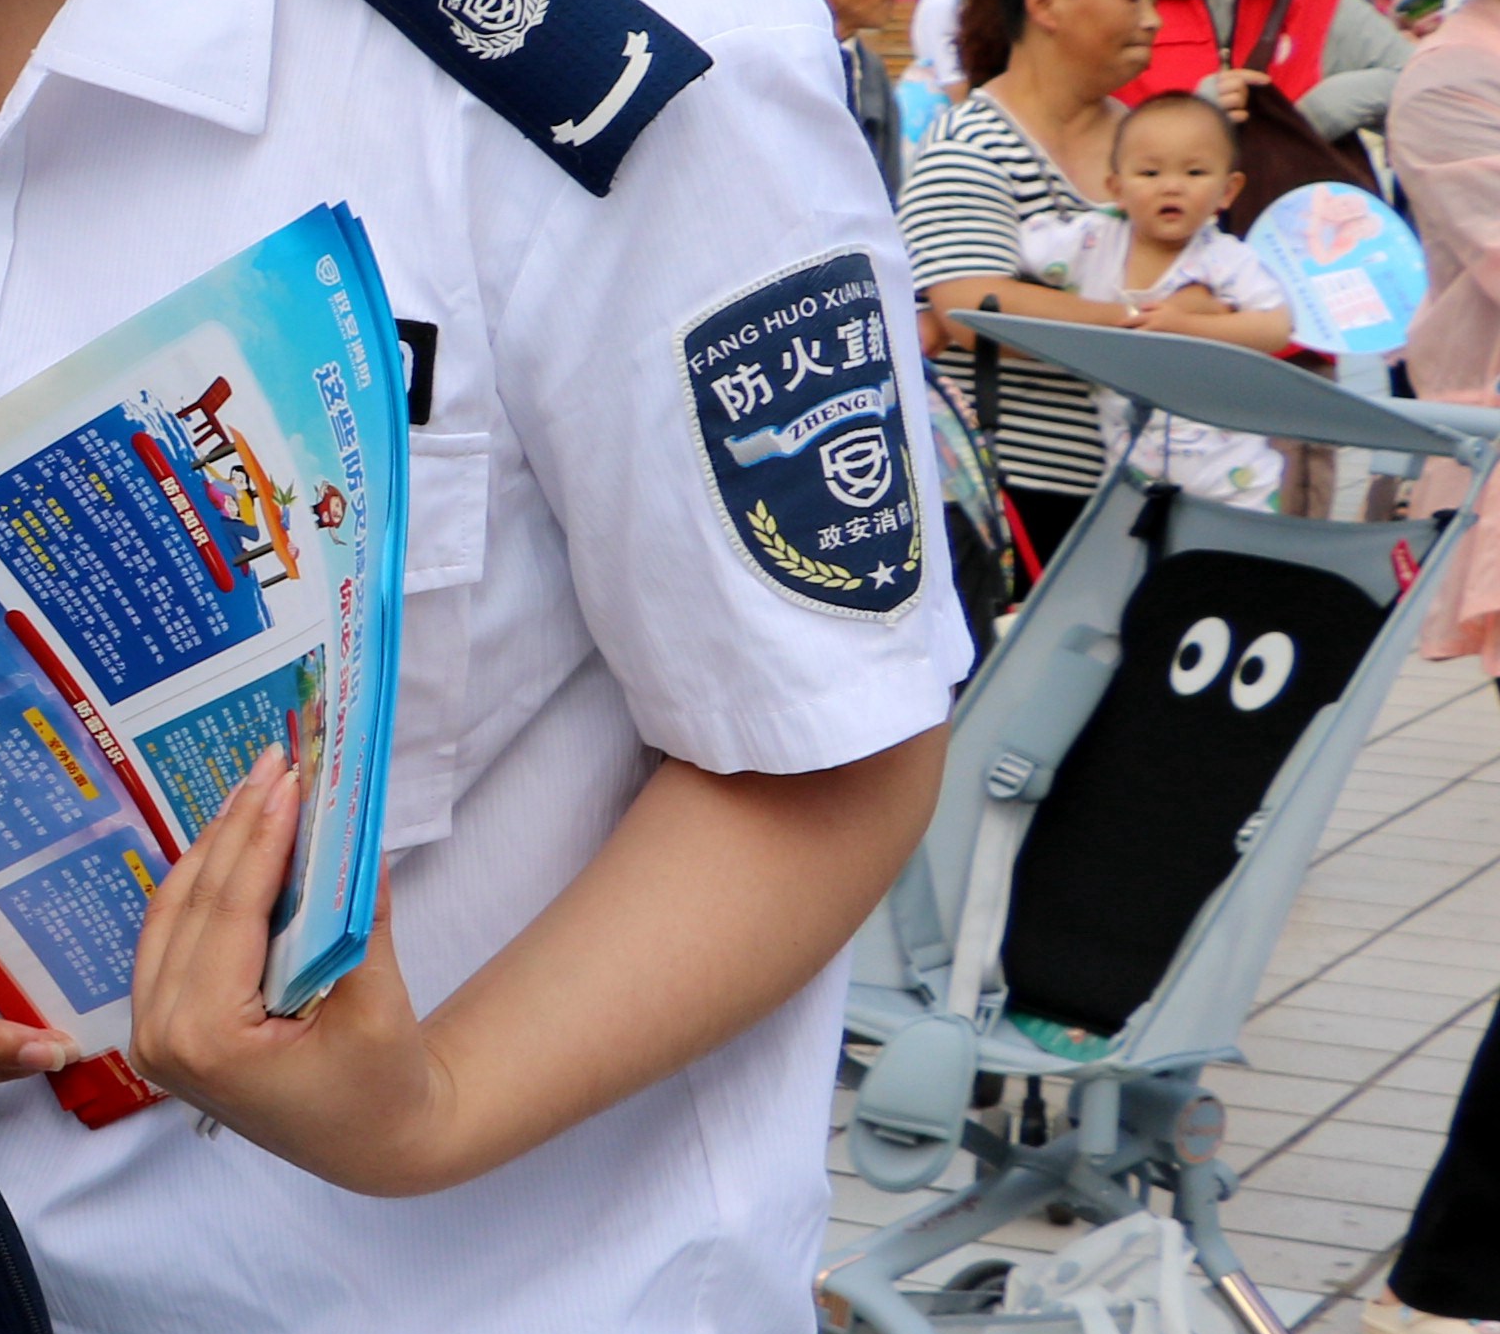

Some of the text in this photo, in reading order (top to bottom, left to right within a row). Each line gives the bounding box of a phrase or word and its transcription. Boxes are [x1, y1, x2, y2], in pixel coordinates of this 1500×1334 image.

[328, 288, 377, 390] 政安消防
[689, 296, 819, 375] FANG HUO
[710, 311, 888, 422] 防火宣教
[788, 394, 869, 442] ZHENG
[156, 474, 213, 548] 防震知识
[818, 499, 912, 553] 政安消防
[32, 717, 89, 789] 2、室外防雷
[72, 698, 126, 767] 防雷知识
